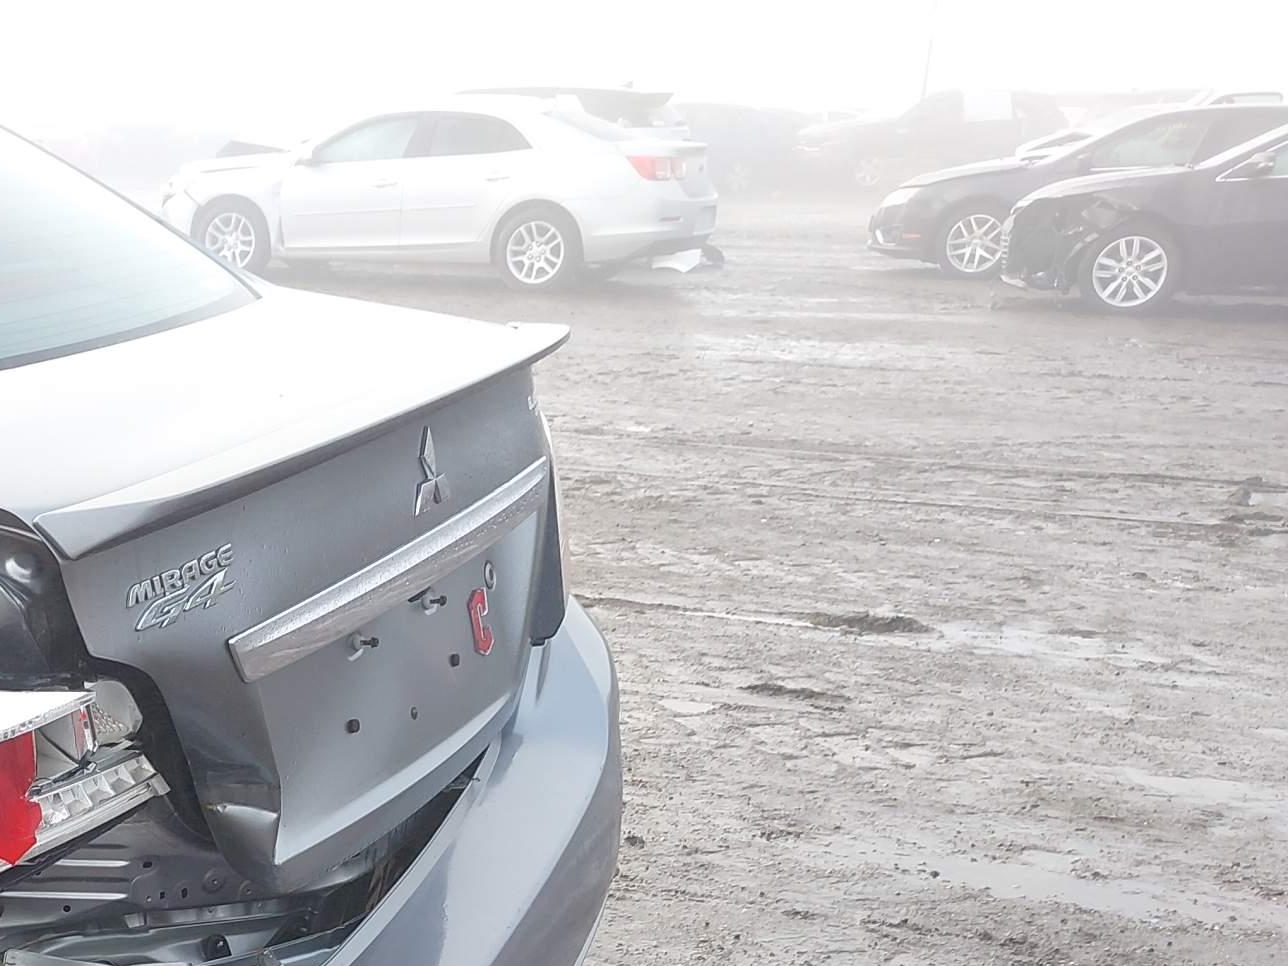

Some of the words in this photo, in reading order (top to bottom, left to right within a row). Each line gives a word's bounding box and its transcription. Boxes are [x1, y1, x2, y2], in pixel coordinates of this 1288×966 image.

[126, 542, 233, 608] MIRAGE
[135, 567, 237, 631] G4
[467, 587, 494, 656] C
